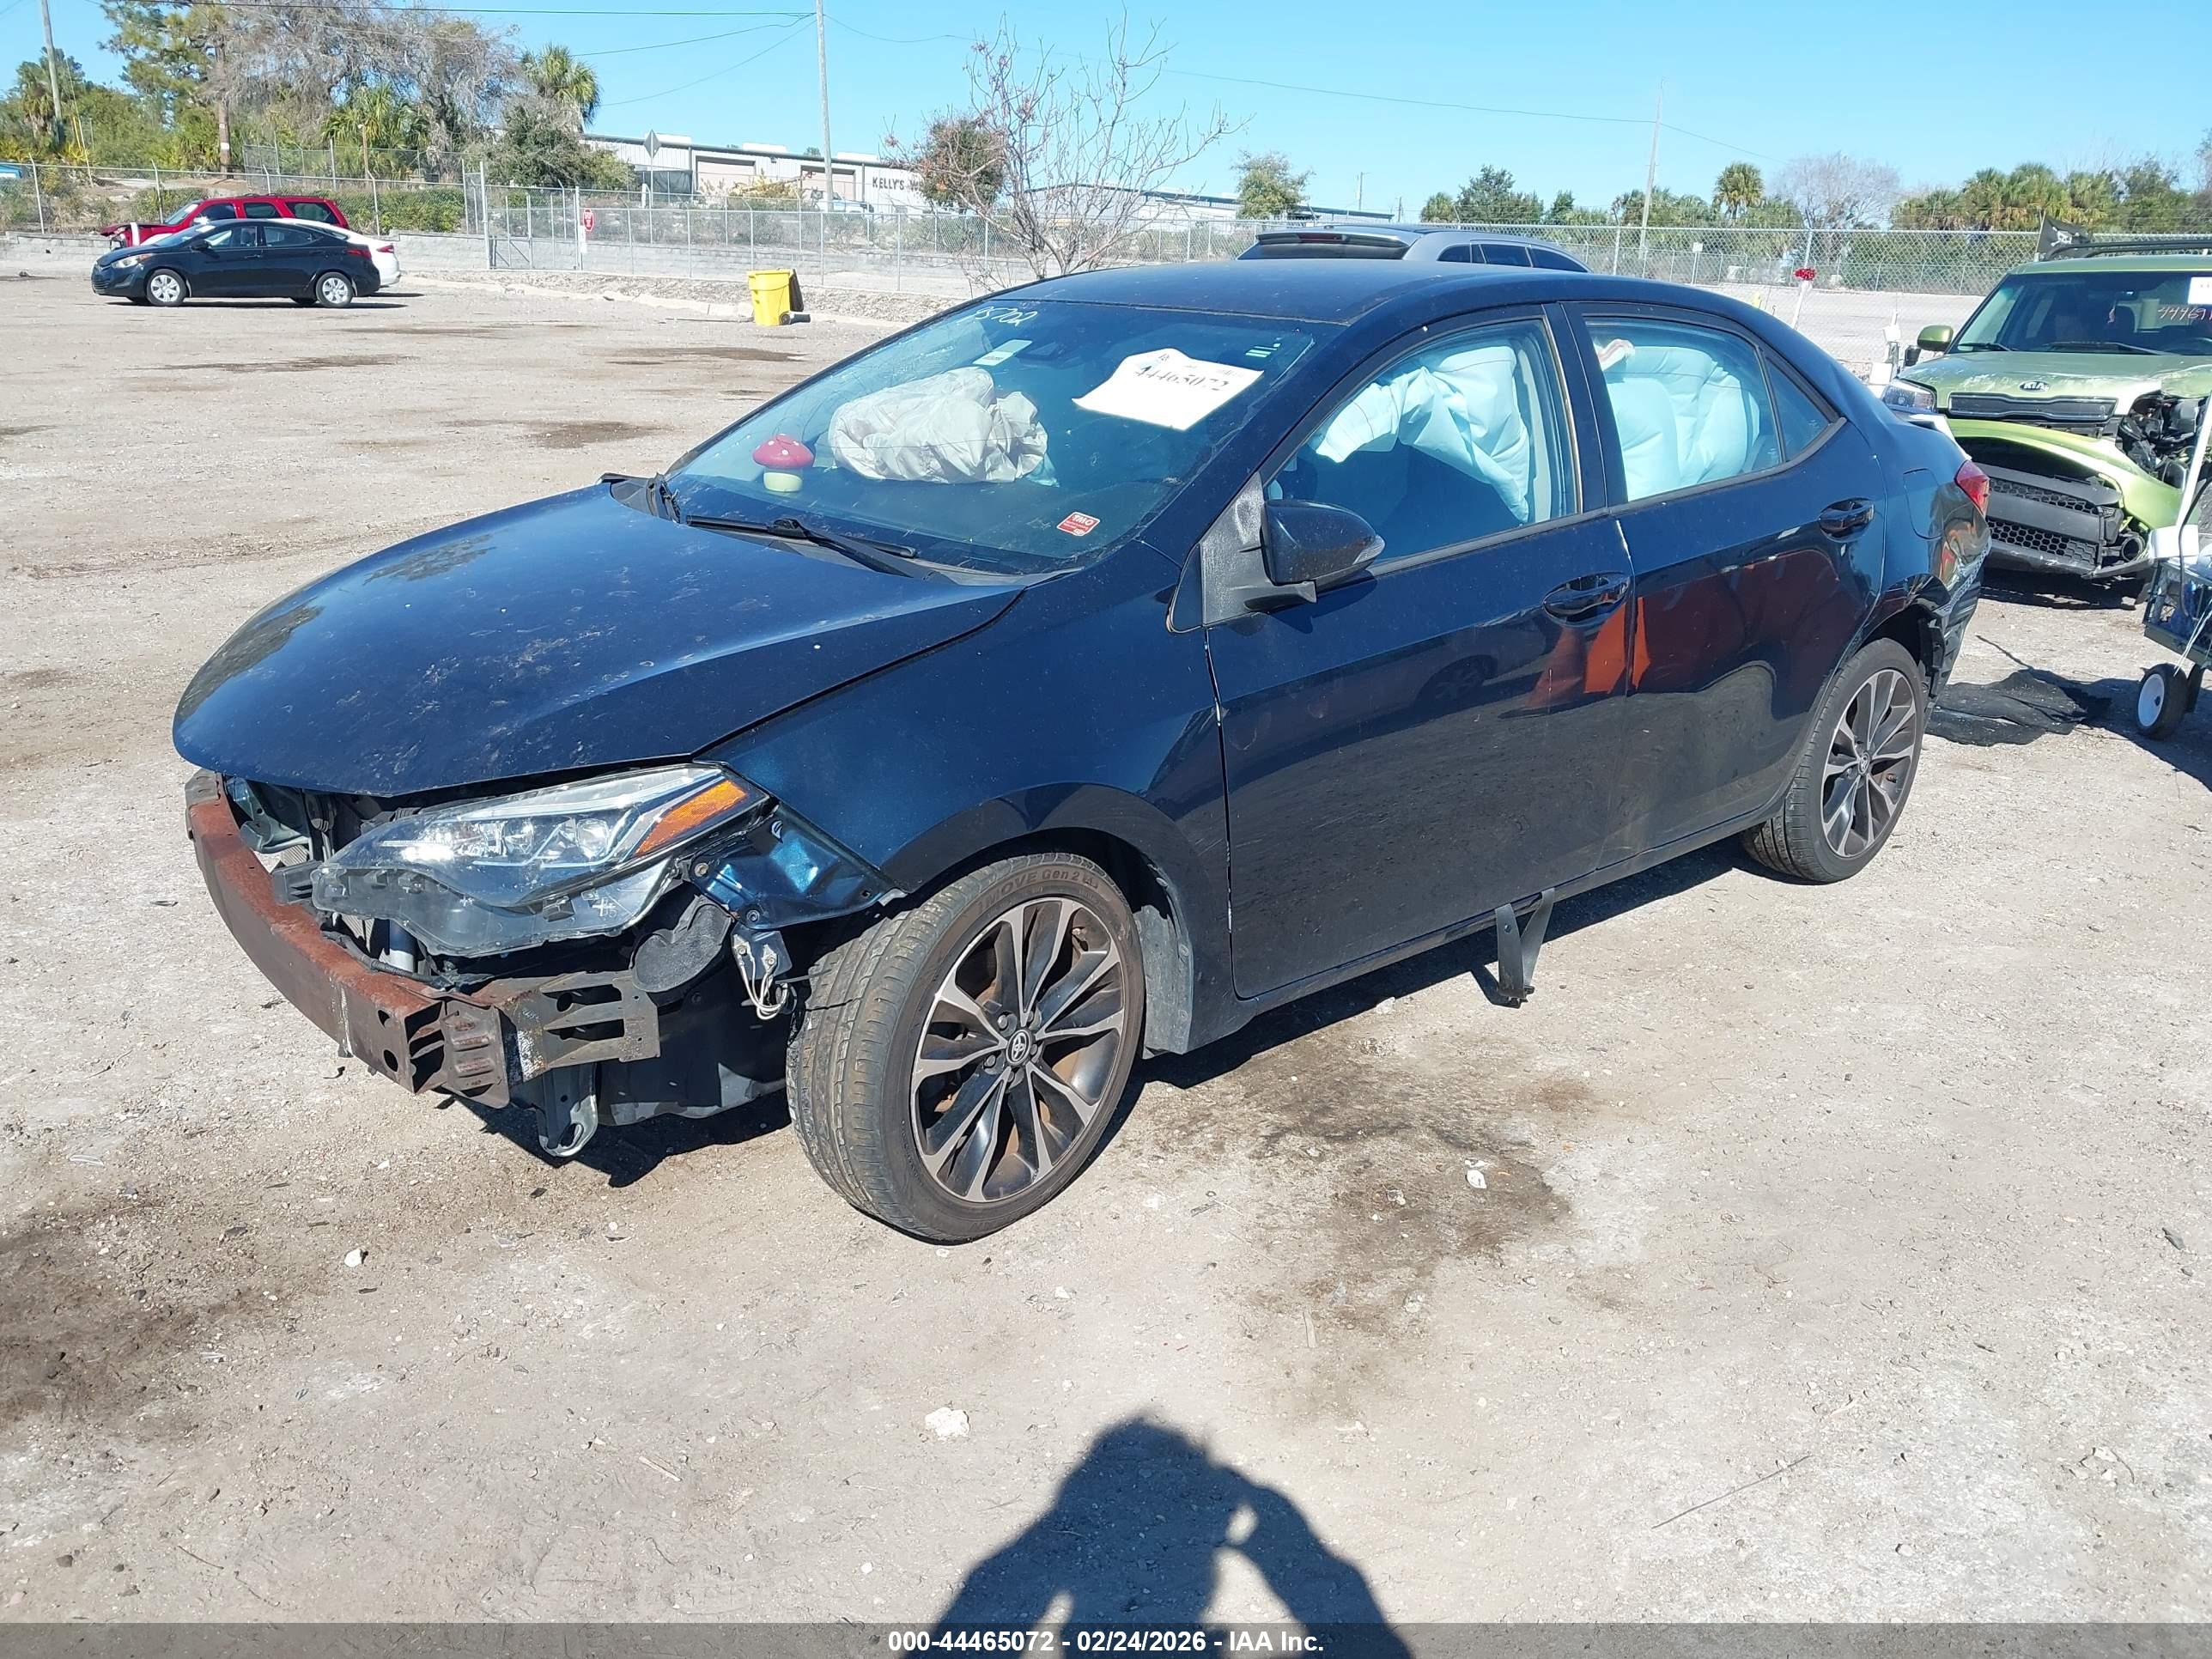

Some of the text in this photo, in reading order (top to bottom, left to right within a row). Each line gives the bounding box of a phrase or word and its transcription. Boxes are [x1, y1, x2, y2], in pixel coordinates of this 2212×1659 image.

[872, 177, 905, 190] KELLY'S
[1042, 868, 1069, 881] Gen
[1072, 871, 1080, 881] 2
